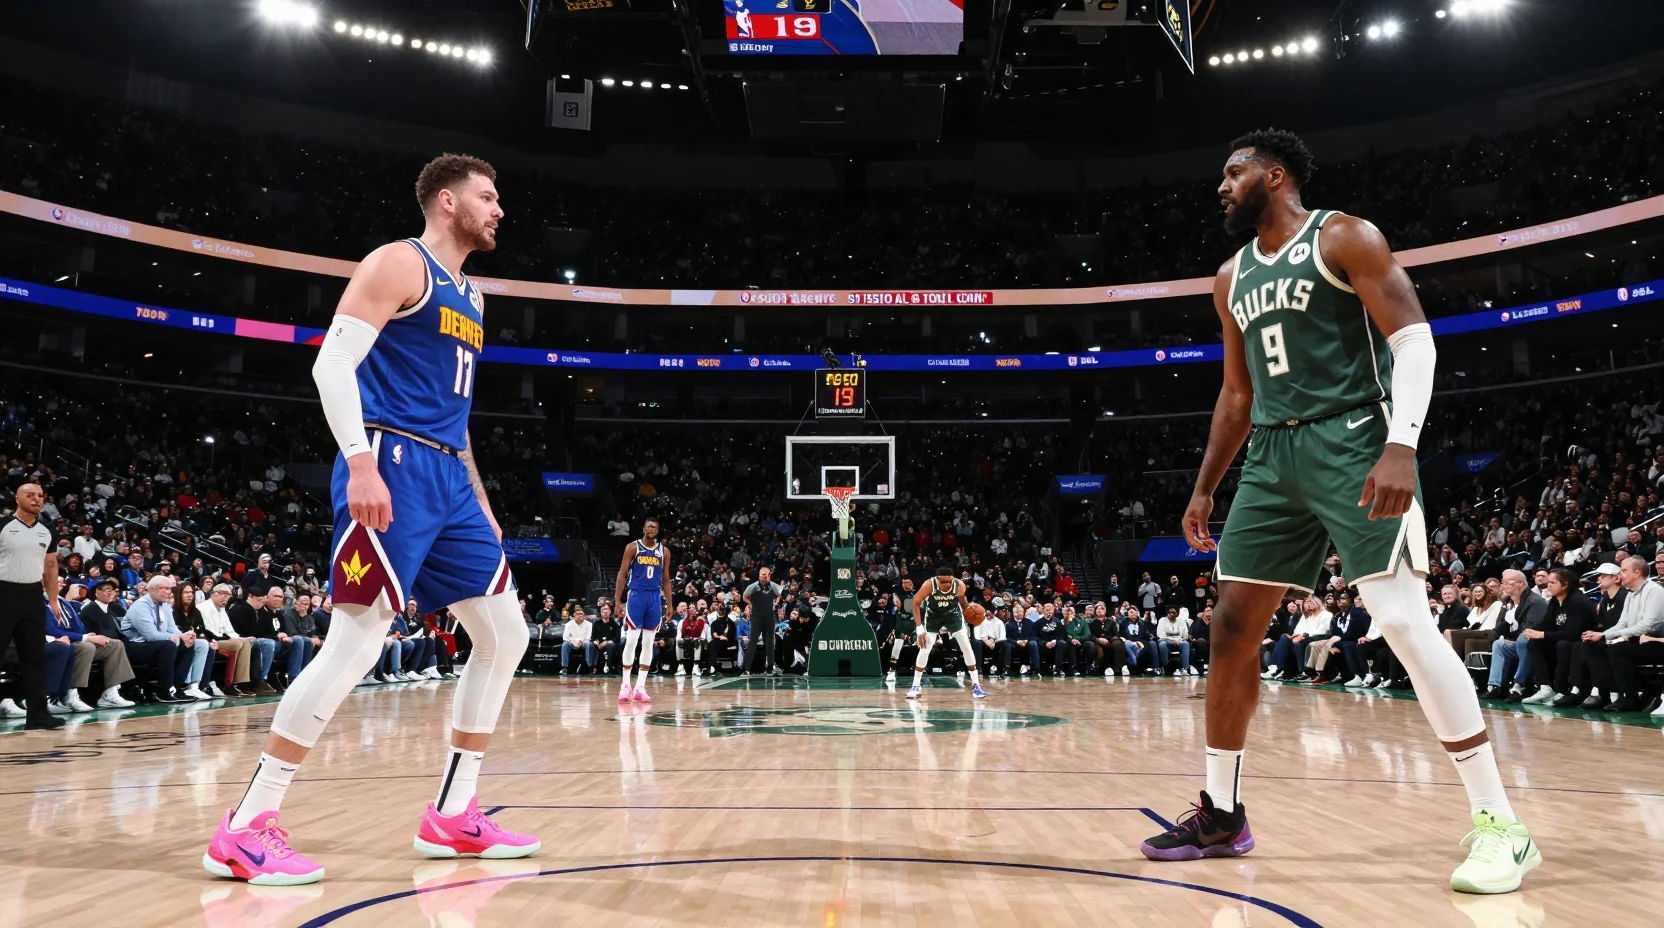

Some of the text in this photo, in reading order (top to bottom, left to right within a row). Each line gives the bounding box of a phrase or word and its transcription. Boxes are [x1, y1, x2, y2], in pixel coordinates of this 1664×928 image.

[774, 16, 817, 37] 19
[1232, 278, 1315, 333] BUCKS
[1261, 323, 1290, 377] 9
[835, 387, 854, 406] 19
